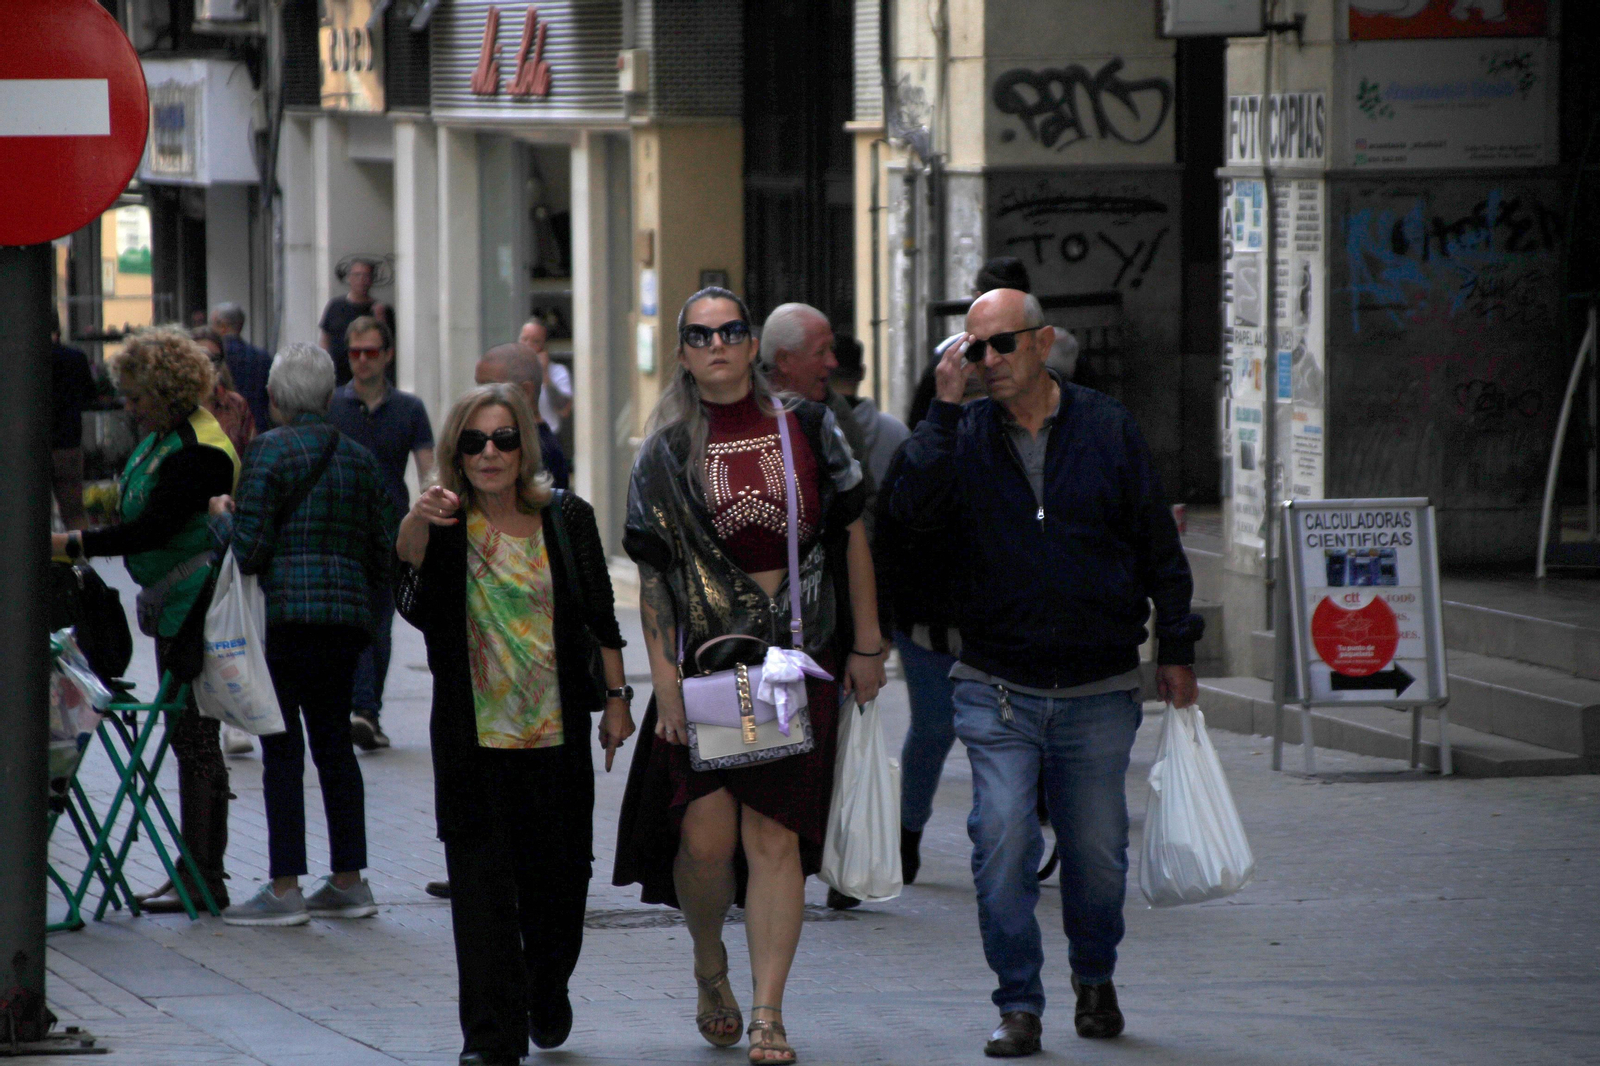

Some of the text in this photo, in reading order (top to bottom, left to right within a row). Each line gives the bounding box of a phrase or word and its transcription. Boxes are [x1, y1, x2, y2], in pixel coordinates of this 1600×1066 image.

[1229, 95, 1324, 160] FOTOCOPIAS
[1234, 330, 1253, 346] PAPEL
[1254, 331, 1262, 346] A4
[1305, 511, 1412, 530] CALCULADORAS
[1306, 531, 1413, 548] CIENTIFICAS
[1344, 592, 1361, 603] ctt
